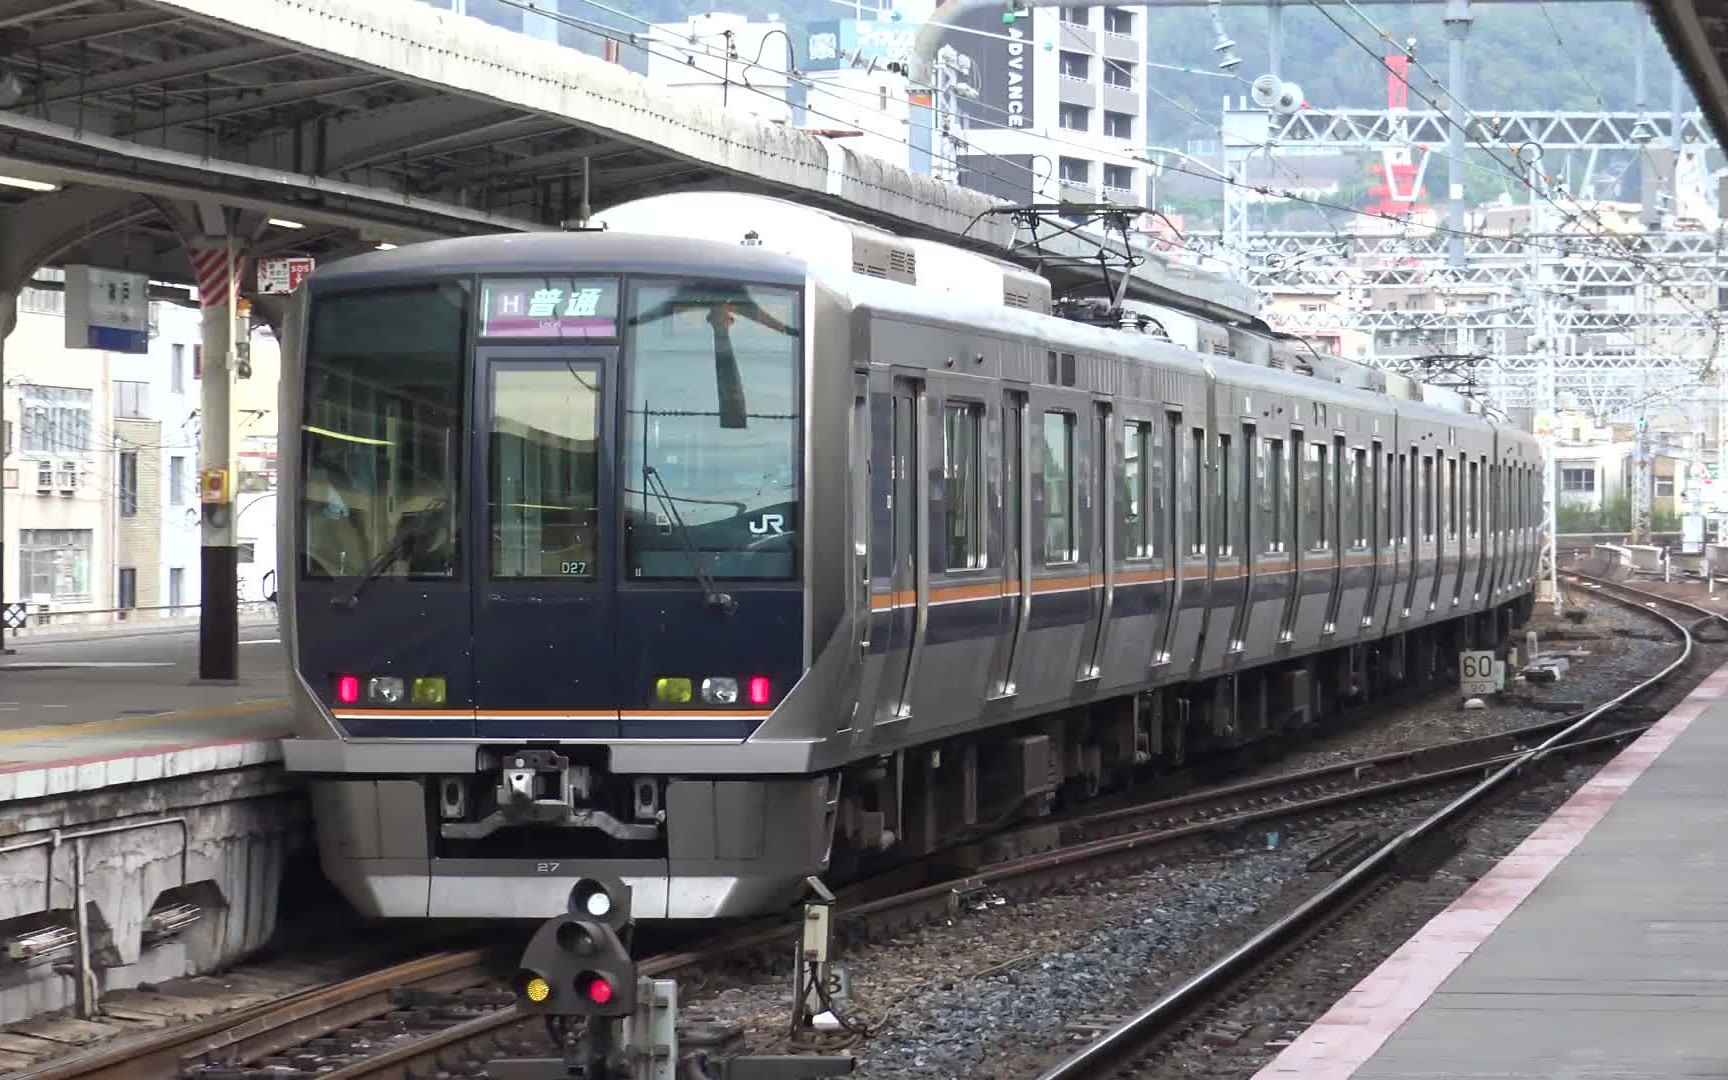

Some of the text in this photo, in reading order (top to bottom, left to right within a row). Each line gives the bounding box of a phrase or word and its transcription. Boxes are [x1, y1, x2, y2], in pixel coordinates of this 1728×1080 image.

[1008, 28, 1023, 127] ADVANCE
[503, 295, 519, 313] H
[528, 288, 602, 316] 普通
[749, 514, 784, 534] JR
[1463, 655, 1491, 677] 60
[537, 862, 560, 872] 27
